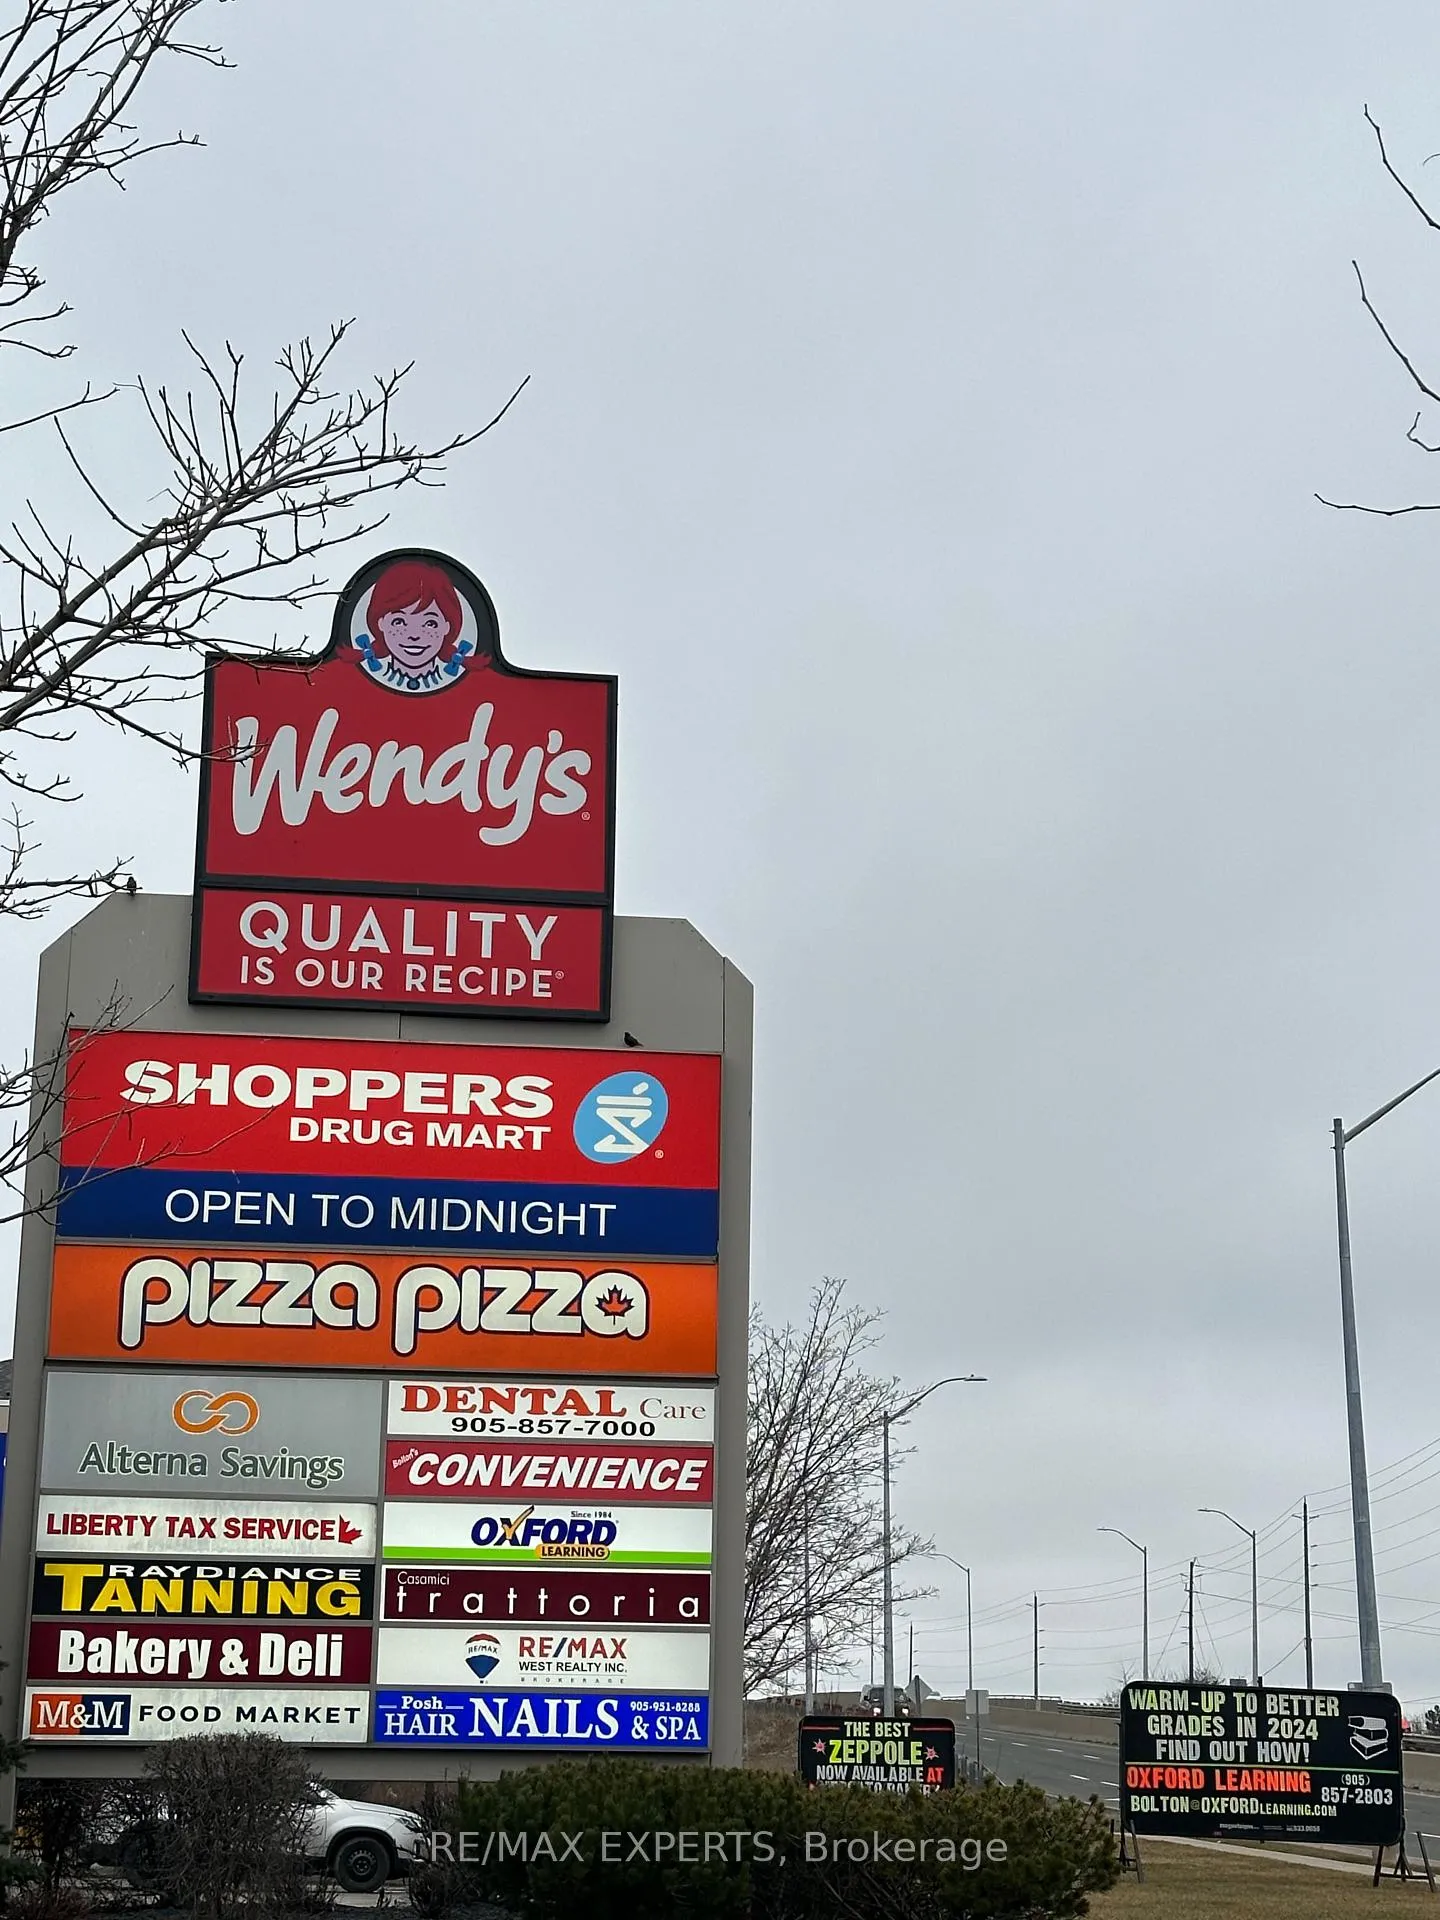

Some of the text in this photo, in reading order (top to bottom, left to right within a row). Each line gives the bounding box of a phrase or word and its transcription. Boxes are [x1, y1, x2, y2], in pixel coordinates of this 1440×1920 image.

[232, 703, 592, 846] Wendy's
[239, 901, 558, 961] QUALITY
[240, 956, 553, 998] IS OUR RECIPE
[120, 1060, 554, 1119] SHOPPERS
[289, 1117, 551, 1151] DRUG MART
[165, 1188, 616, 1237] OPEN TO MIDNIGHT
[118, 1257, 650, 1358] pizza pizza
[400, 1385, 706, 1420] DENTAL Care
[451, 1417, 656, 1437] 905-857-7000
[77, 1441, 345, 1489] Alterna Savings
[408, 1453, 708, 1491] CONVENIENCE
[46, 1513, 336, 1540] LIBERTY TAX SERVICE
[571, 1510, 612, 1519] Since 1984
[471, 1515, 617, 1547] OXFORD
[541, 1546, 605, 1557] LEARNING
[109, 1565, 361, 1582] RAYDIANCE
[397, 1571, 450, 1587] Casamici
[44, 1563, 361, 1616] TANNING
[397, 1586, 700, 1618] trattoria
[58, 1629, 343, 1679] Bakery & Deli
[468, 1645, 498, 1655] RE/MAX
[519, 1636, 627, 1659] RE/MAX
[519, 1662, 627, 1673] WEST REALTY INC.
[37, 1699, 361, 1729] M&M FOOD MARKET
[401, 1696, 444, 1710] Posh
[1128, 1689, 1340, 1717] WARM-UP TO BETTER
[384, 1697, 702, 1740] HAIR NAILS & SPA
[844, 1721, 911, 1738] THE BEST
[1147, 1715, 1319, 1741] GRADES IN 2024
[829, 1739, 923, 1765] ZEPPOLE
[1156, 1739, 1310, 1764] FIND OUT HOW!
[816, 1765, 944, 1783] NOW AVAILABLE AT
[1127, 1766, 1312, 1793] OXFORD LEARNING
[1341, 1774, 1371, 1787] (905)
[1321, 1786, 1394, 1806] 857-2803
